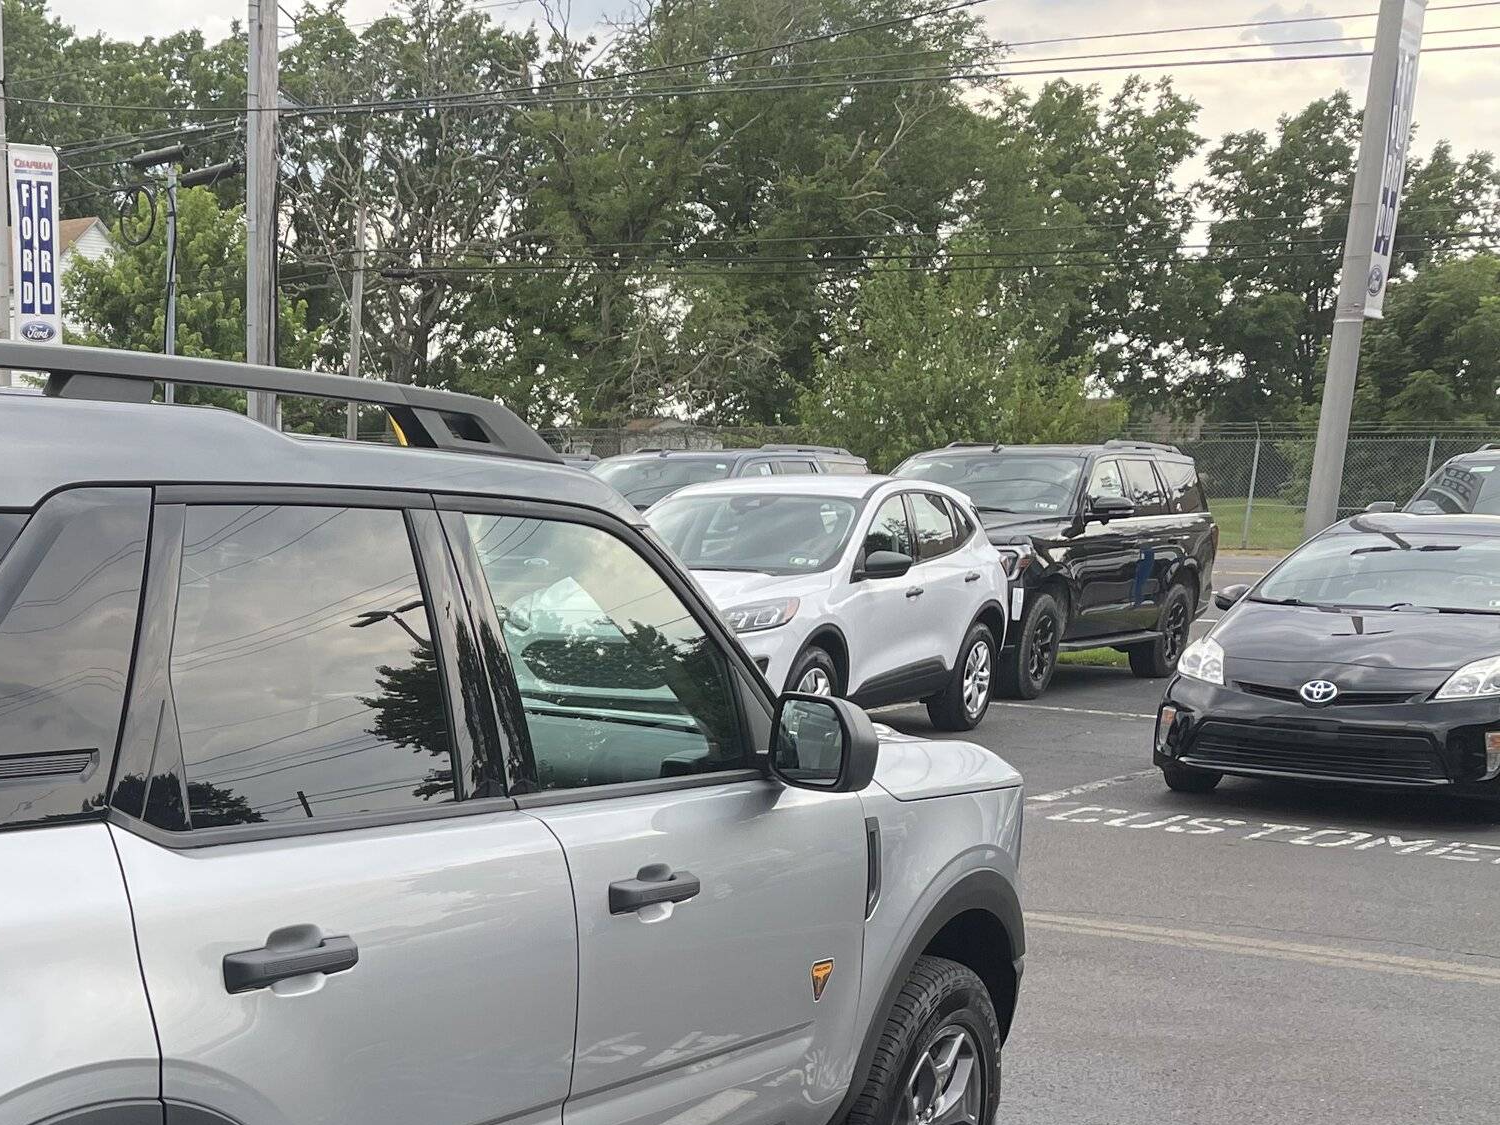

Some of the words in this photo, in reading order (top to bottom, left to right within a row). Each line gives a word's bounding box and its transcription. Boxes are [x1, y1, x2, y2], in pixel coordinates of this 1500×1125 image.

[20, 183, 34, 305] FORD
[40, 185, 53, 305] FORD
[1046, 806, 1500, 865] CUSTOME
